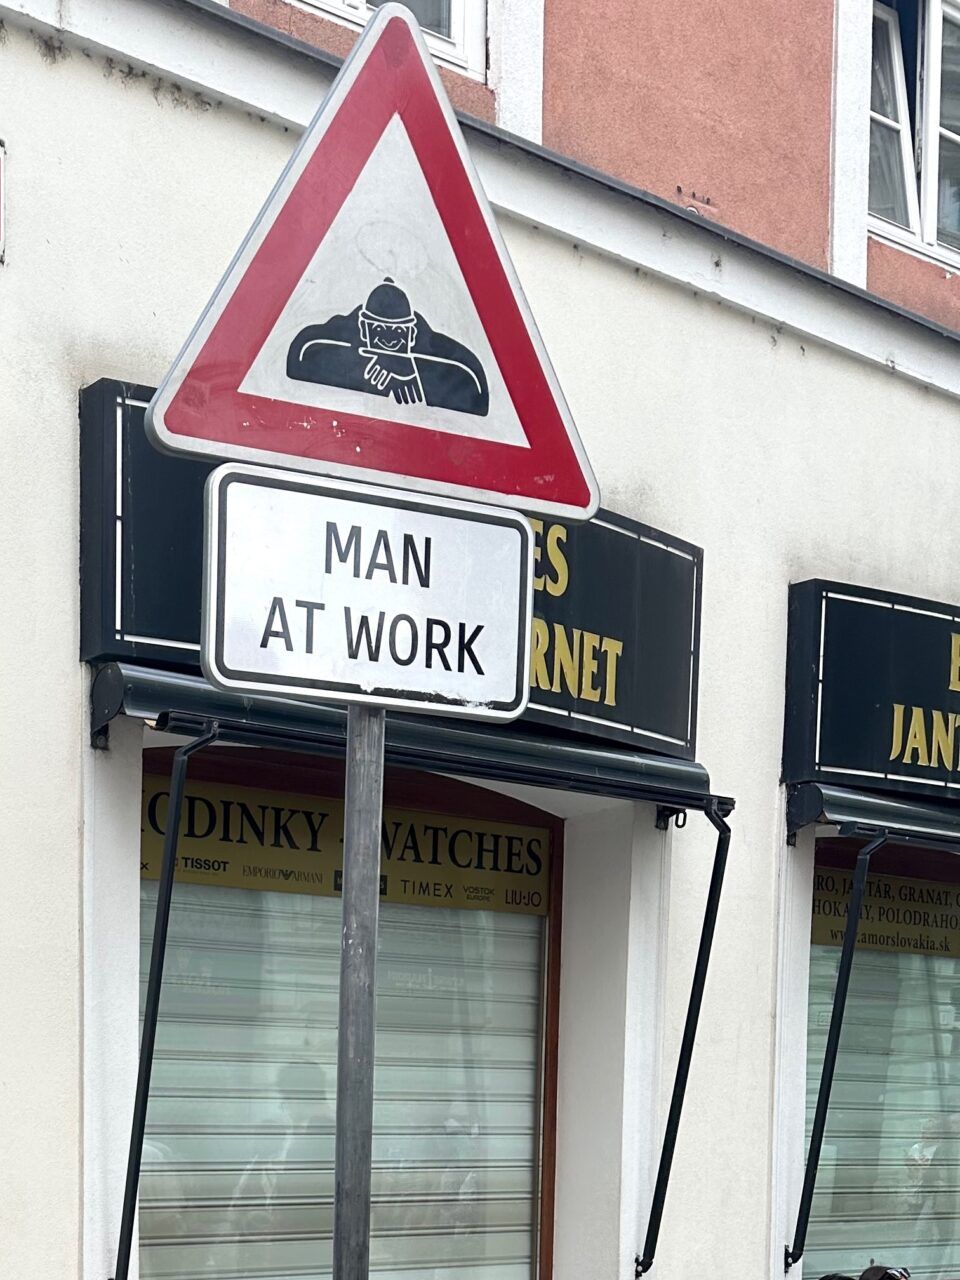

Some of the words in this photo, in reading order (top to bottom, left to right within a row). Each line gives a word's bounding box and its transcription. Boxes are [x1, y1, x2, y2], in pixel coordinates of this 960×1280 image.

[324, 520, 432, 589] MAN
[259, 596, 326, 655] AT
[343, 605, 486, 676] WORK
[141, 788, 330, 853] ODINKY
[181, 856, 230, 873] TISSOT
[400, 879, 454, 899] TIMEX
[463, 884, 495, 895] VOSTOK
[878, 905, 960, 931] POLODRAHO
[830, 929, 951, 953] w.amorslovakia.sk
